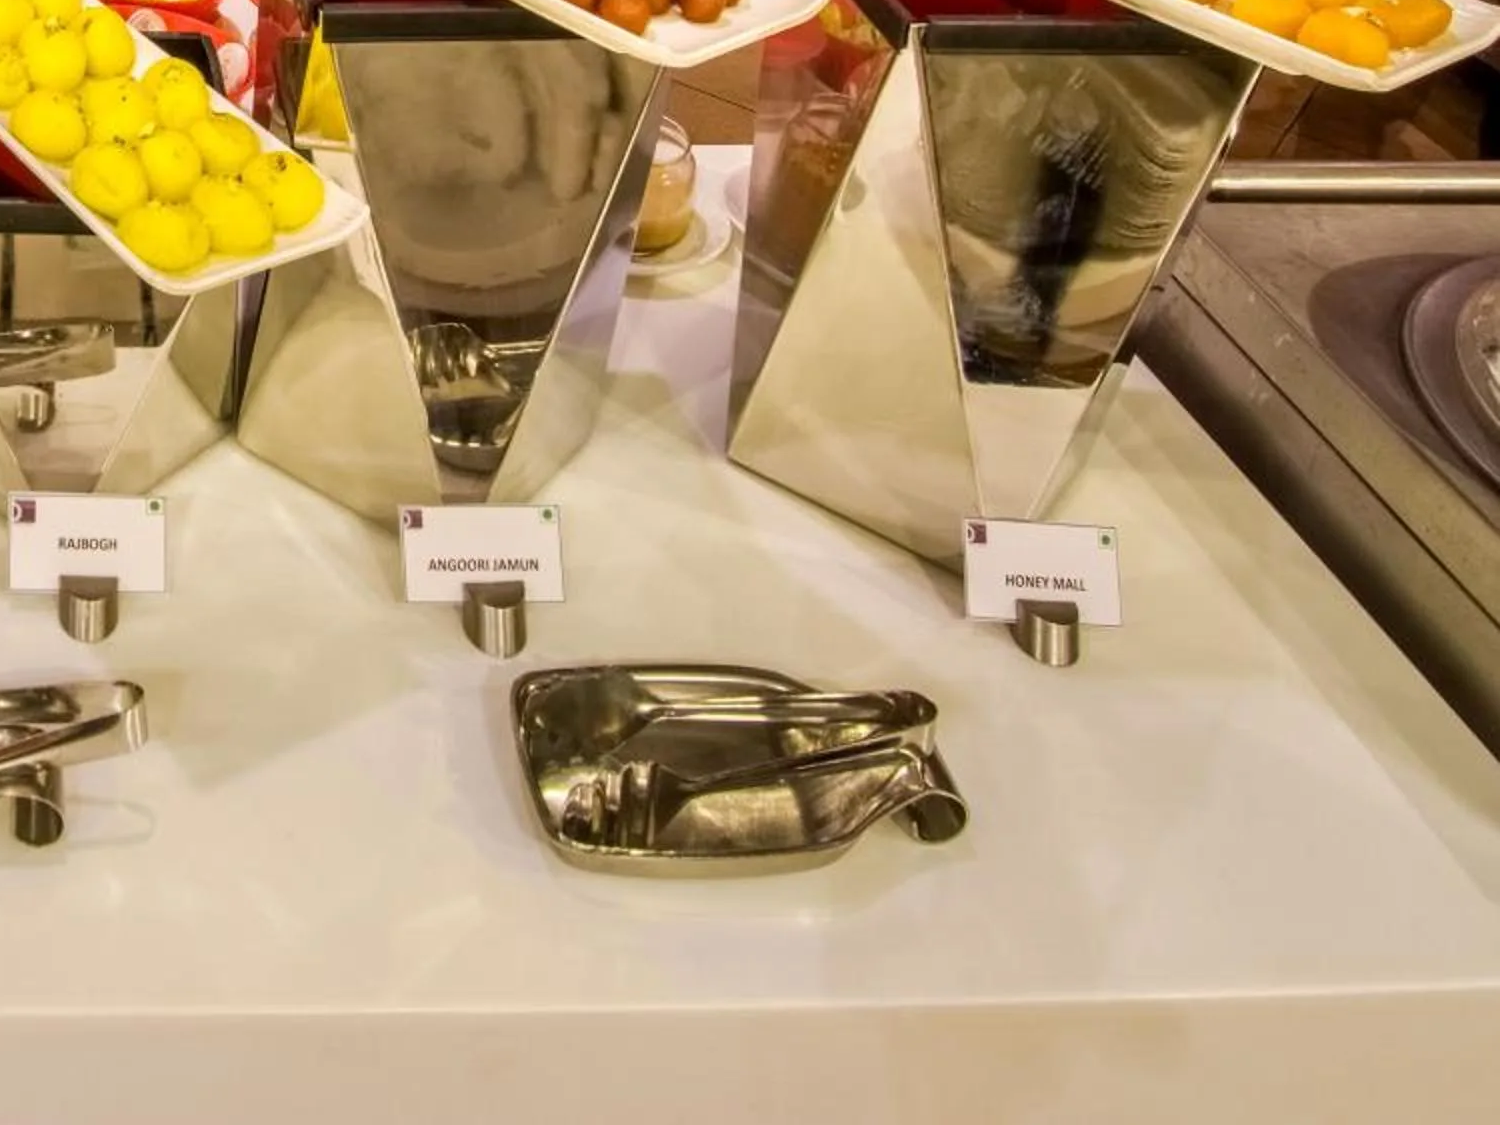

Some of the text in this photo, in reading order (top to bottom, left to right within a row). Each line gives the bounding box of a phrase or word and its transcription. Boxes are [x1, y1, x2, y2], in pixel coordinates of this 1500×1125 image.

[58, 538, 117, 550] RAJBOGH
[428, 558, 539, 572] ANGOORI JAMUN
[1005, 574, 1087, 592] HONEY MALL
